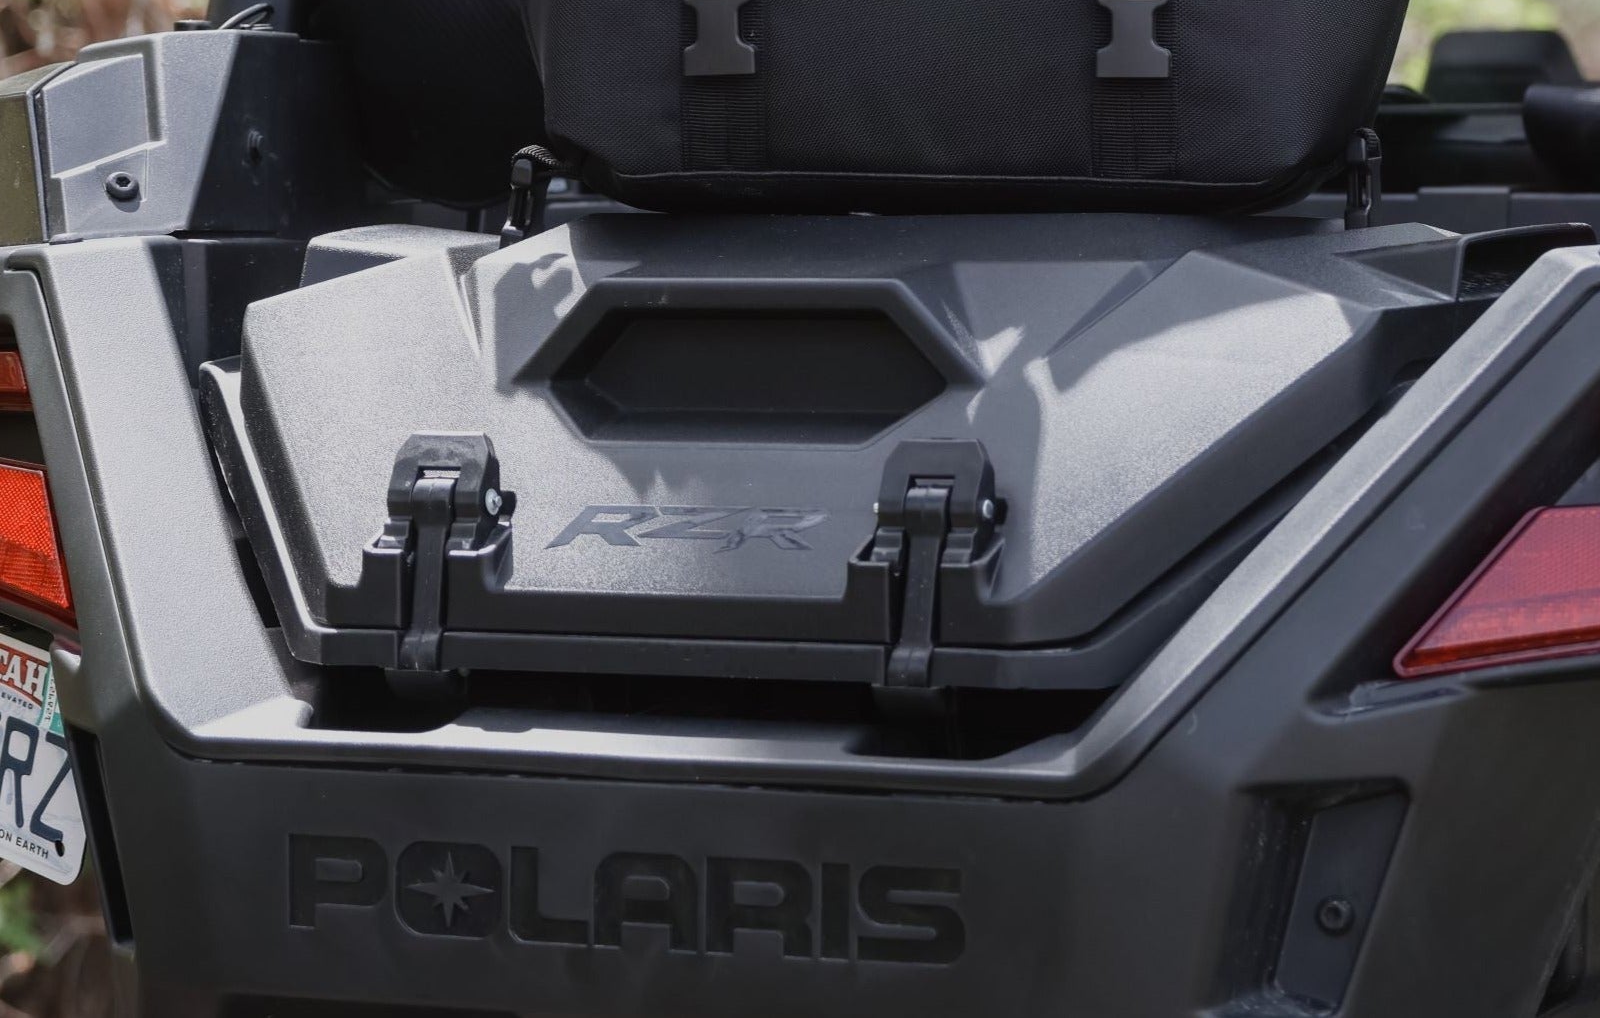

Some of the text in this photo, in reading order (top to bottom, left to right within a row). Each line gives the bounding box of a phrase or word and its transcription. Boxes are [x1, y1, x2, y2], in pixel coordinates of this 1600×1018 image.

[543, 505, 830, 554] RZR
[0, 712, 70, 843] RZ
[15, 836, 50, 860] EARTH
[287, 832, 968, 967] POLARIS
